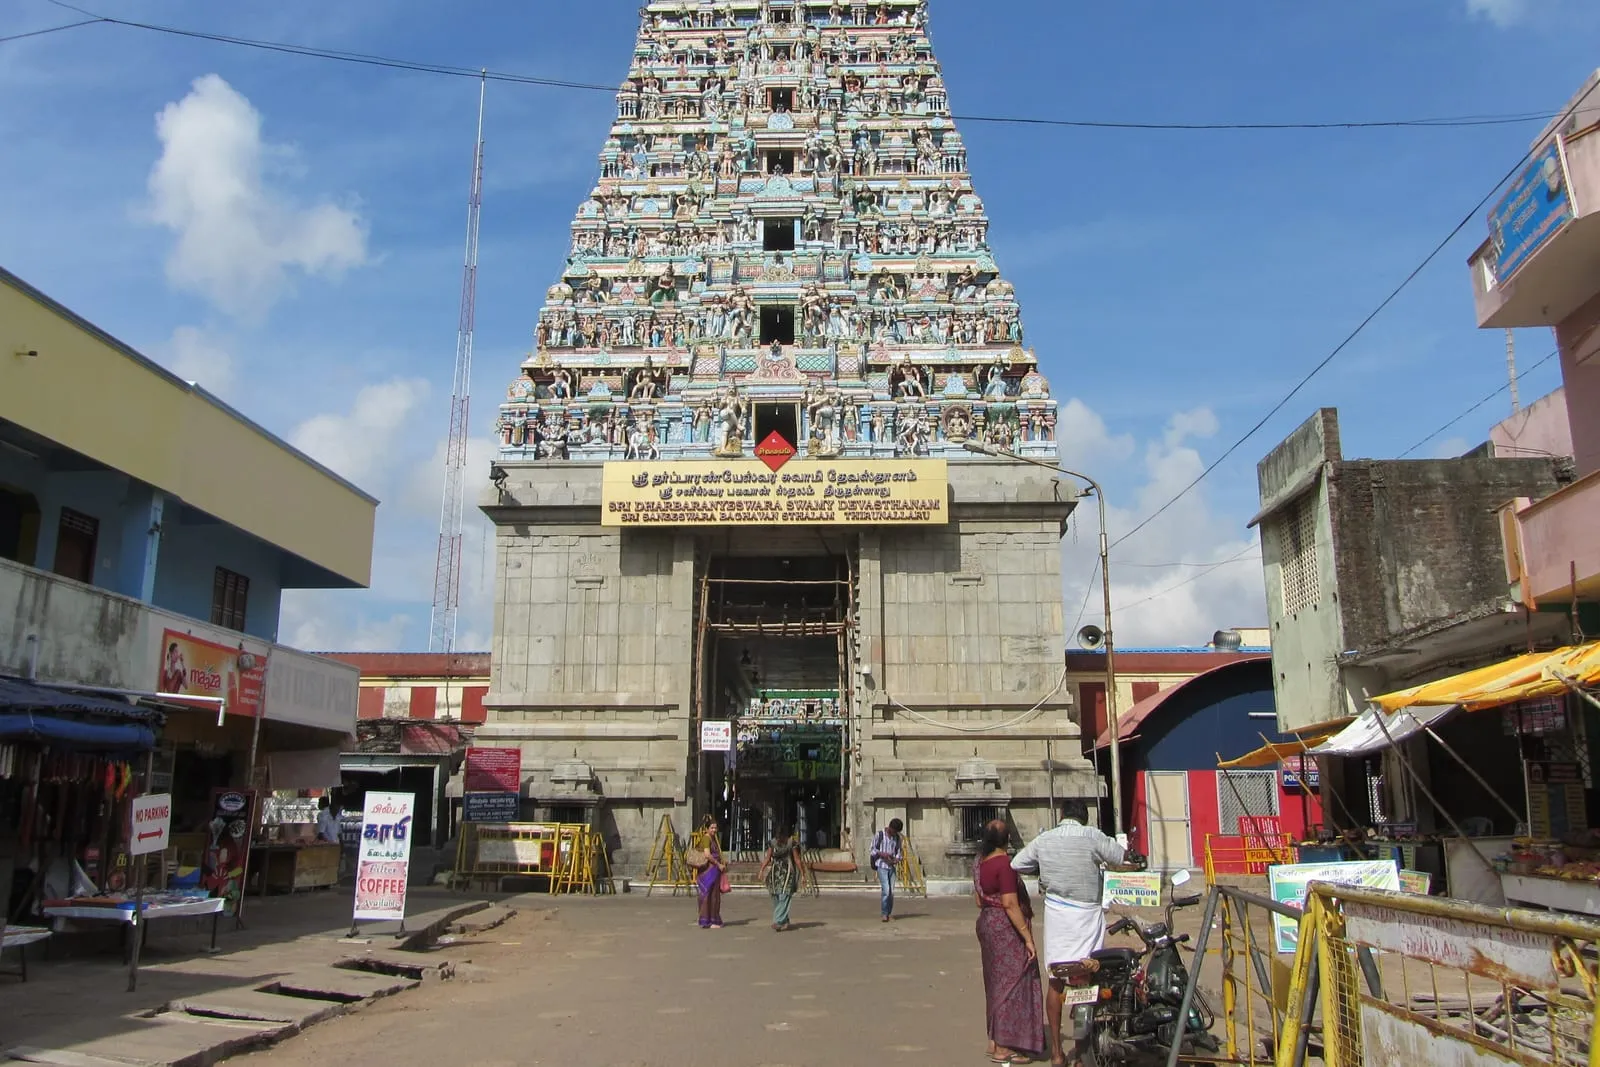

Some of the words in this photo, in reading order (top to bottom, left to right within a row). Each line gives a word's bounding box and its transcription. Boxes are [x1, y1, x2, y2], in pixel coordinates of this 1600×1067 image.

[781, 470, 824, 484] சுவாமி
[827, 469, 917, 486] தேவஸ்தானம்
[727, 485, 771, 496] பகவான்
[823, 484, 891, 499] திருநள்ளாறு
[609, 501, 631, 512] SRI
[634, 500, 783, 512] DHARBARANYESWARA
[786, 500, 835, 511] SWAMY
[838, 499, 940, 511] DEVASTHANAM
[621, 512, 639, 522] SRI
[643, 512, 717, 522] SANEESWARA
[781, 511, 835, 521] STHALAM
[844, 511, 931, 521] THIRUNALLARU
[190, 668, 222, 690] maaza
[722, 727, 730, 737] 1
[135, 810, 144, 823] NO
[144, 805, 169, 822] PARKING
[364, 815, 411, 844] காபி
[369, 863, 397, 874] Filter
[360, 878, 405, 894] COFFEE
[1110, 888, 1134, 896] CLOAK
[363, 898, 400, 908] Available
